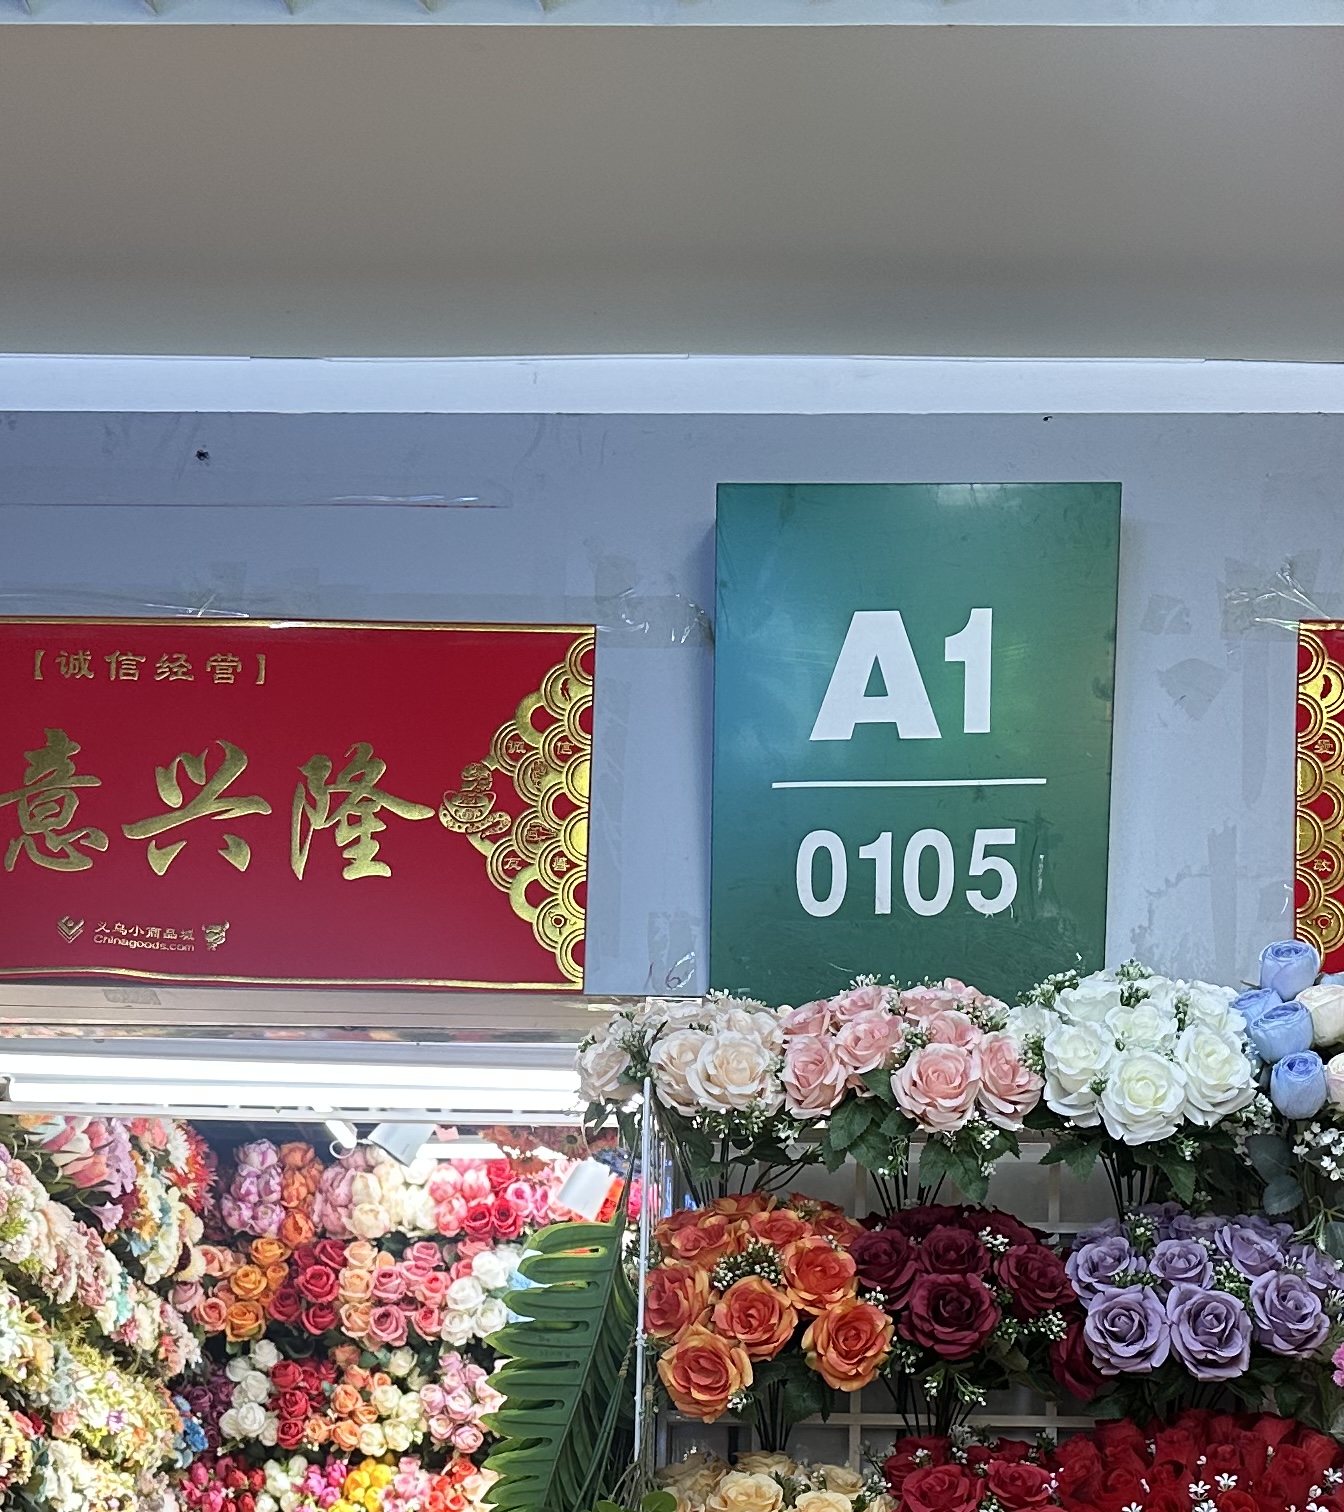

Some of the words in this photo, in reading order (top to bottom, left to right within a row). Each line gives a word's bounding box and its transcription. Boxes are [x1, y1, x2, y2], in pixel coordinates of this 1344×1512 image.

[808, 607, 994, 742] A1
[795, 828, 1018, 918] 0105
[92, 933, 196, 952] Chinagoods.com
